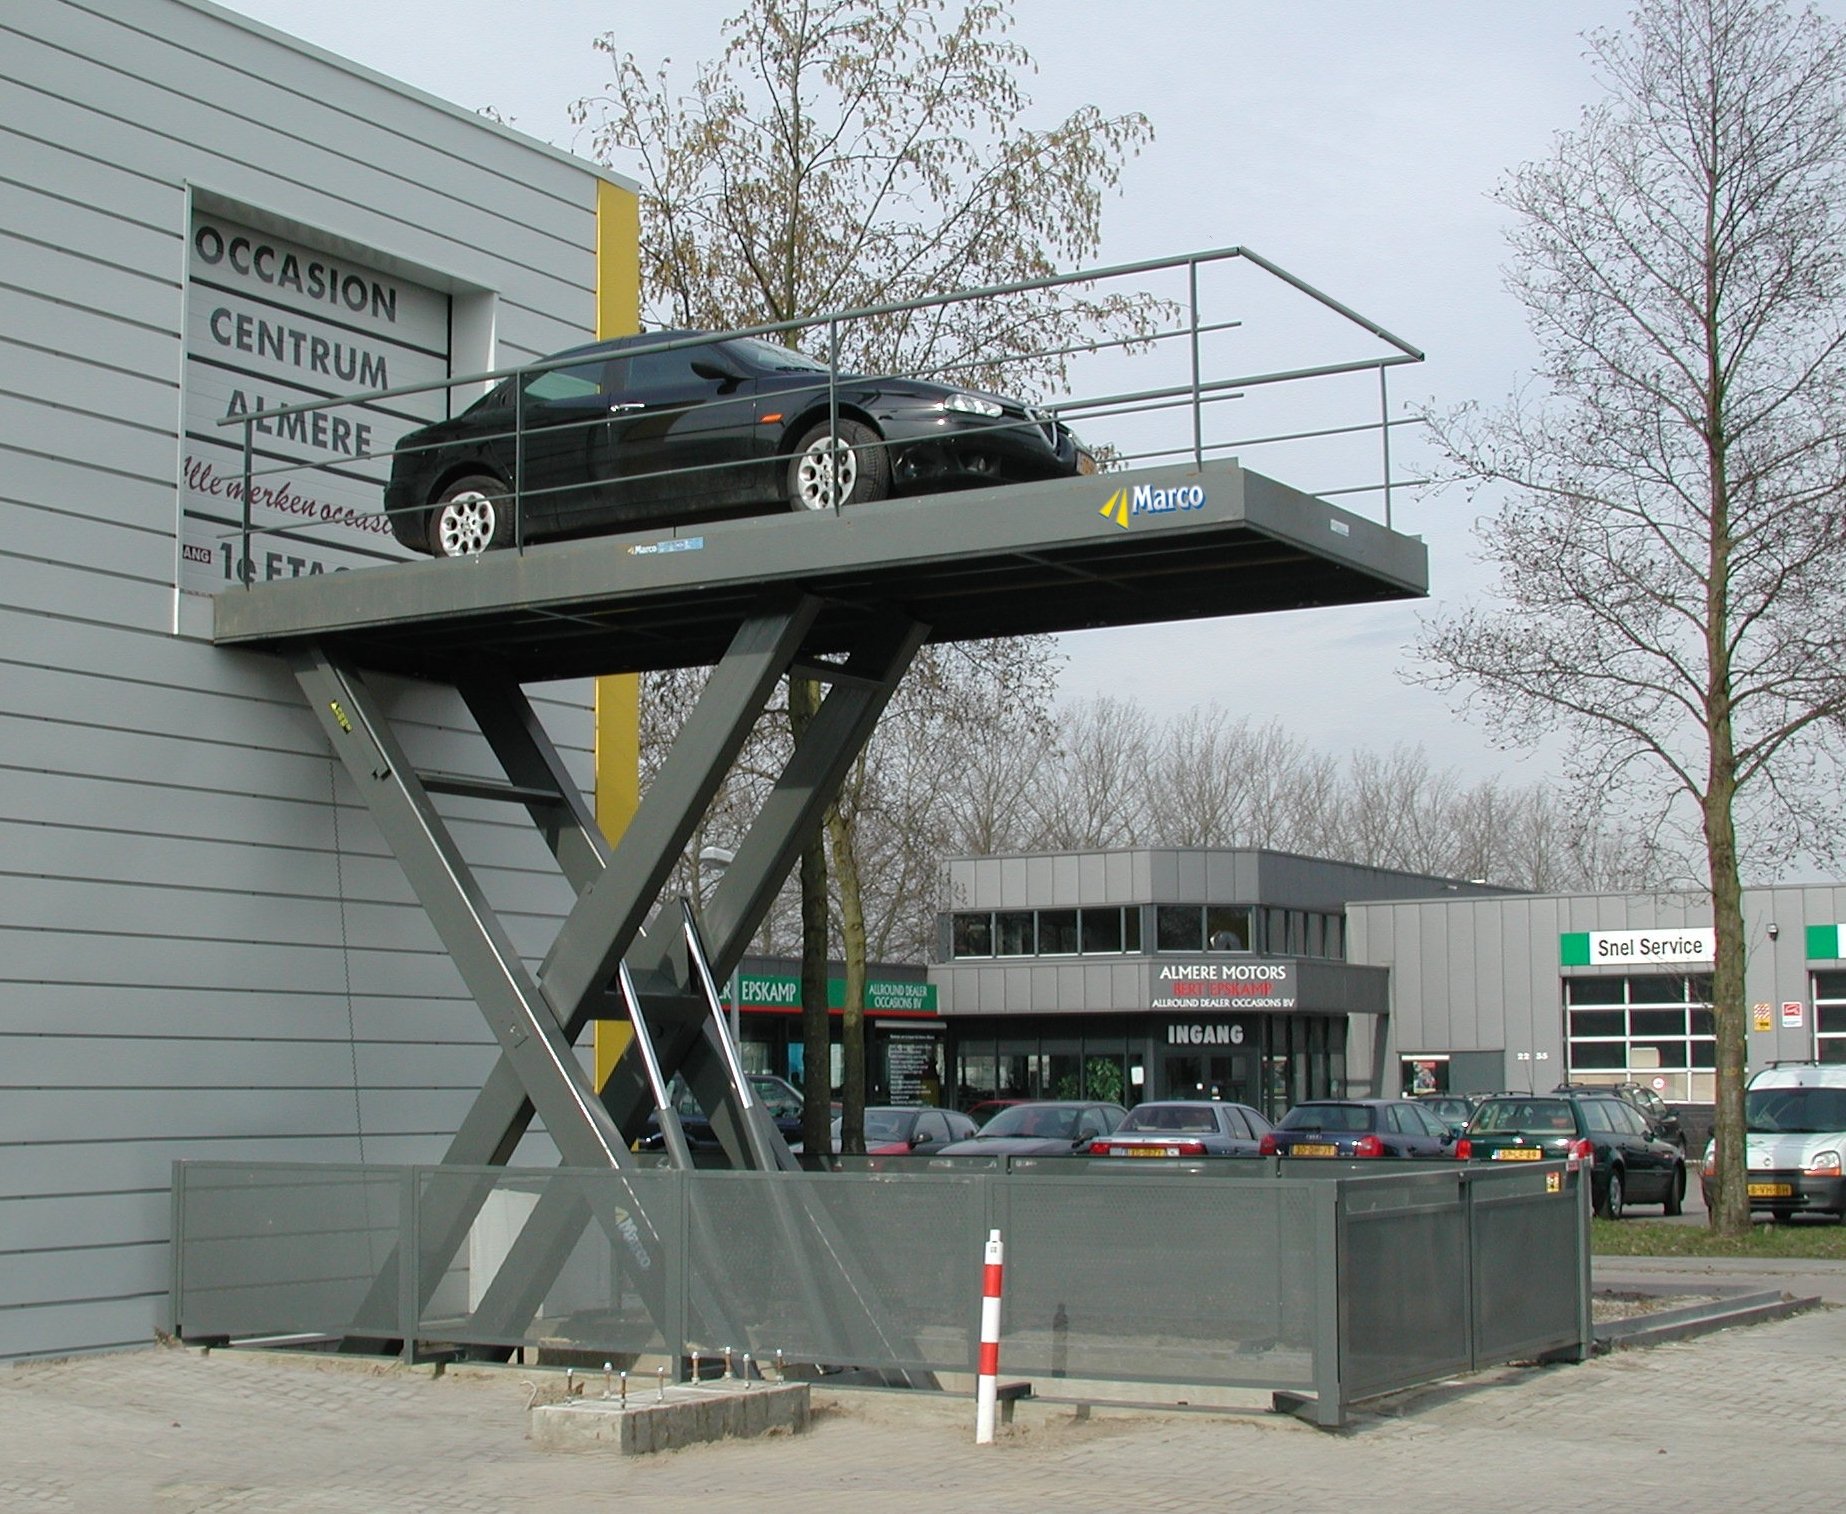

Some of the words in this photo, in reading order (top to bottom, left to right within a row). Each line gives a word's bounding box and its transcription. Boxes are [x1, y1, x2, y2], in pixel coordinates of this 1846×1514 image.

[195, 225, 397, 323] OCCASION
[210, 307, 389, 390] CENTRUM
[225, 389, 373, 459] ALMERE
[227, 482, 318, 518] merken
[1132, 485, 1206, 515] Marco
[1598, 938, 1634, 957] Snel
[1639, 936, 1703, 956] Service
[1159, 965, 1217, 980] ALMERE
[1222, 965, 1287, 980] MOTORS
[742, 981, 797, 1002] EPSKAMP
[868, 984, 904, 996] ALLROUND
[905, 985, 928, 997] DEALER
[1173, 982, 1204, 997] BERT
[1209, 982, 1274, 997] EPSKAMP
[874, 996, 913, 1009] OCCASIONS
[1152, 998, 1198, 1008] ALLROUND
[1200, 998, 1231, 1008] DEALER
[1232, 998, 1281, 1008] OCCASIONS
[1283, 998, 1296, 1008] BV
[1167, 1025, 1244, 1044] INGANG
